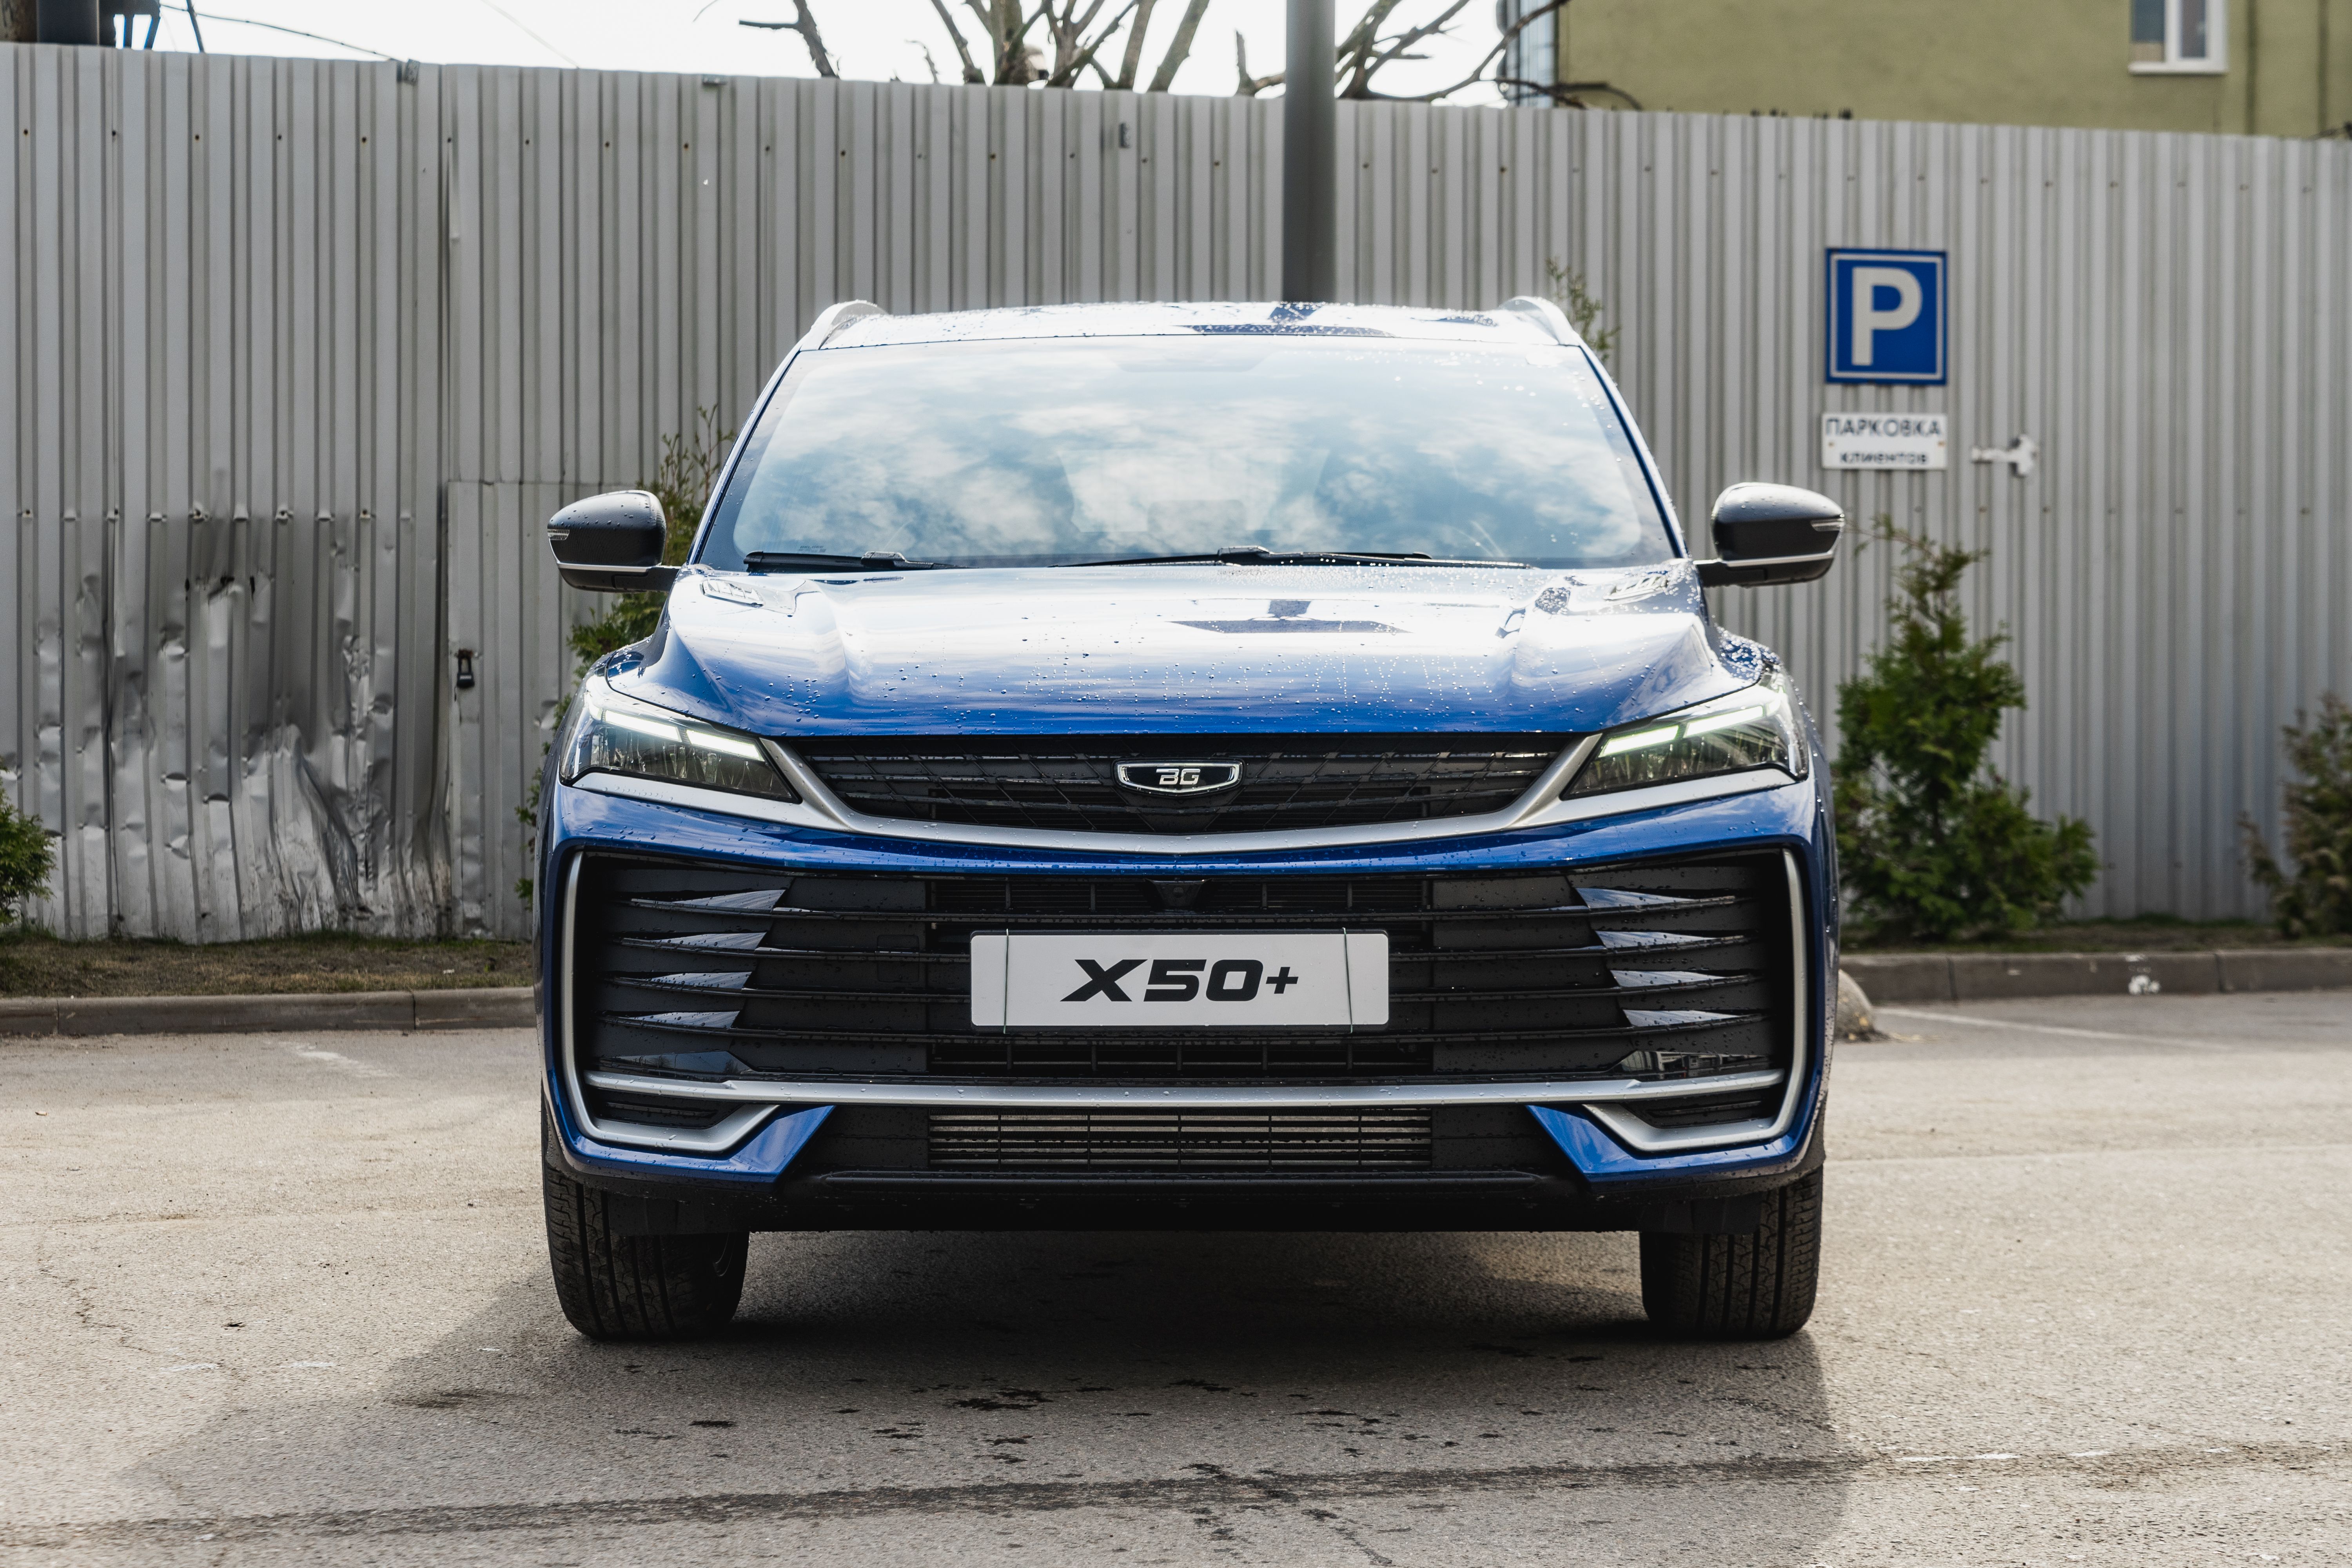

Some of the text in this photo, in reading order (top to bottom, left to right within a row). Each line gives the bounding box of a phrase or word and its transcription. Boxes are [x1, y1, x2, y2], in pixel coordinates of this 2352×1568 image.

[1851, 267, 1922, 366] P
[1826, 417, 1941, 437] ПАРКОВКА
[1060, 959, 1299, 1002] X50+
